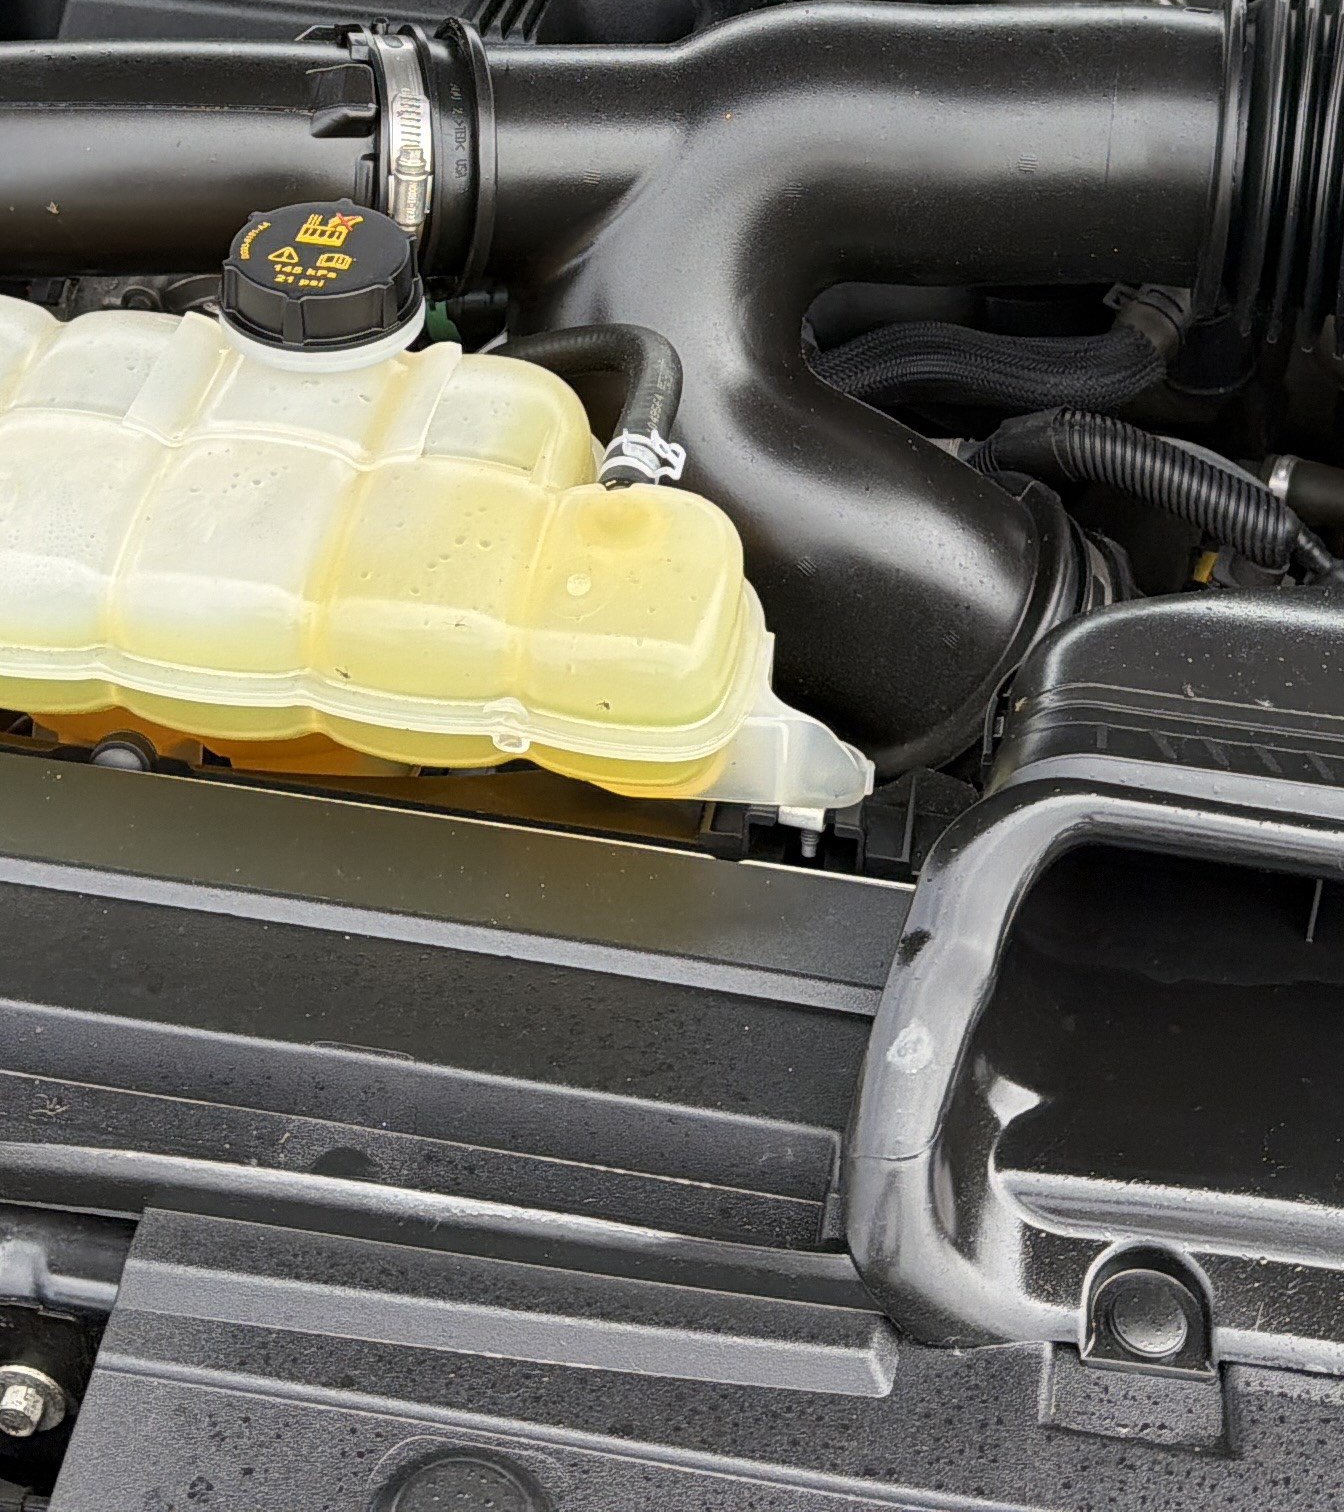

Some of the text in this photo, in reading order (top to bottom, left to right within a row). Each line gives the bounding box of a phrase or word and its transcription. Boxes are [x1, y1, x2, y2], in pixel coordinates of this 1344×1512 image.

[455, 159, 468, 179] USA
[306, 268, 337, 279] kPa
[298, 279, 325, 287] psi
